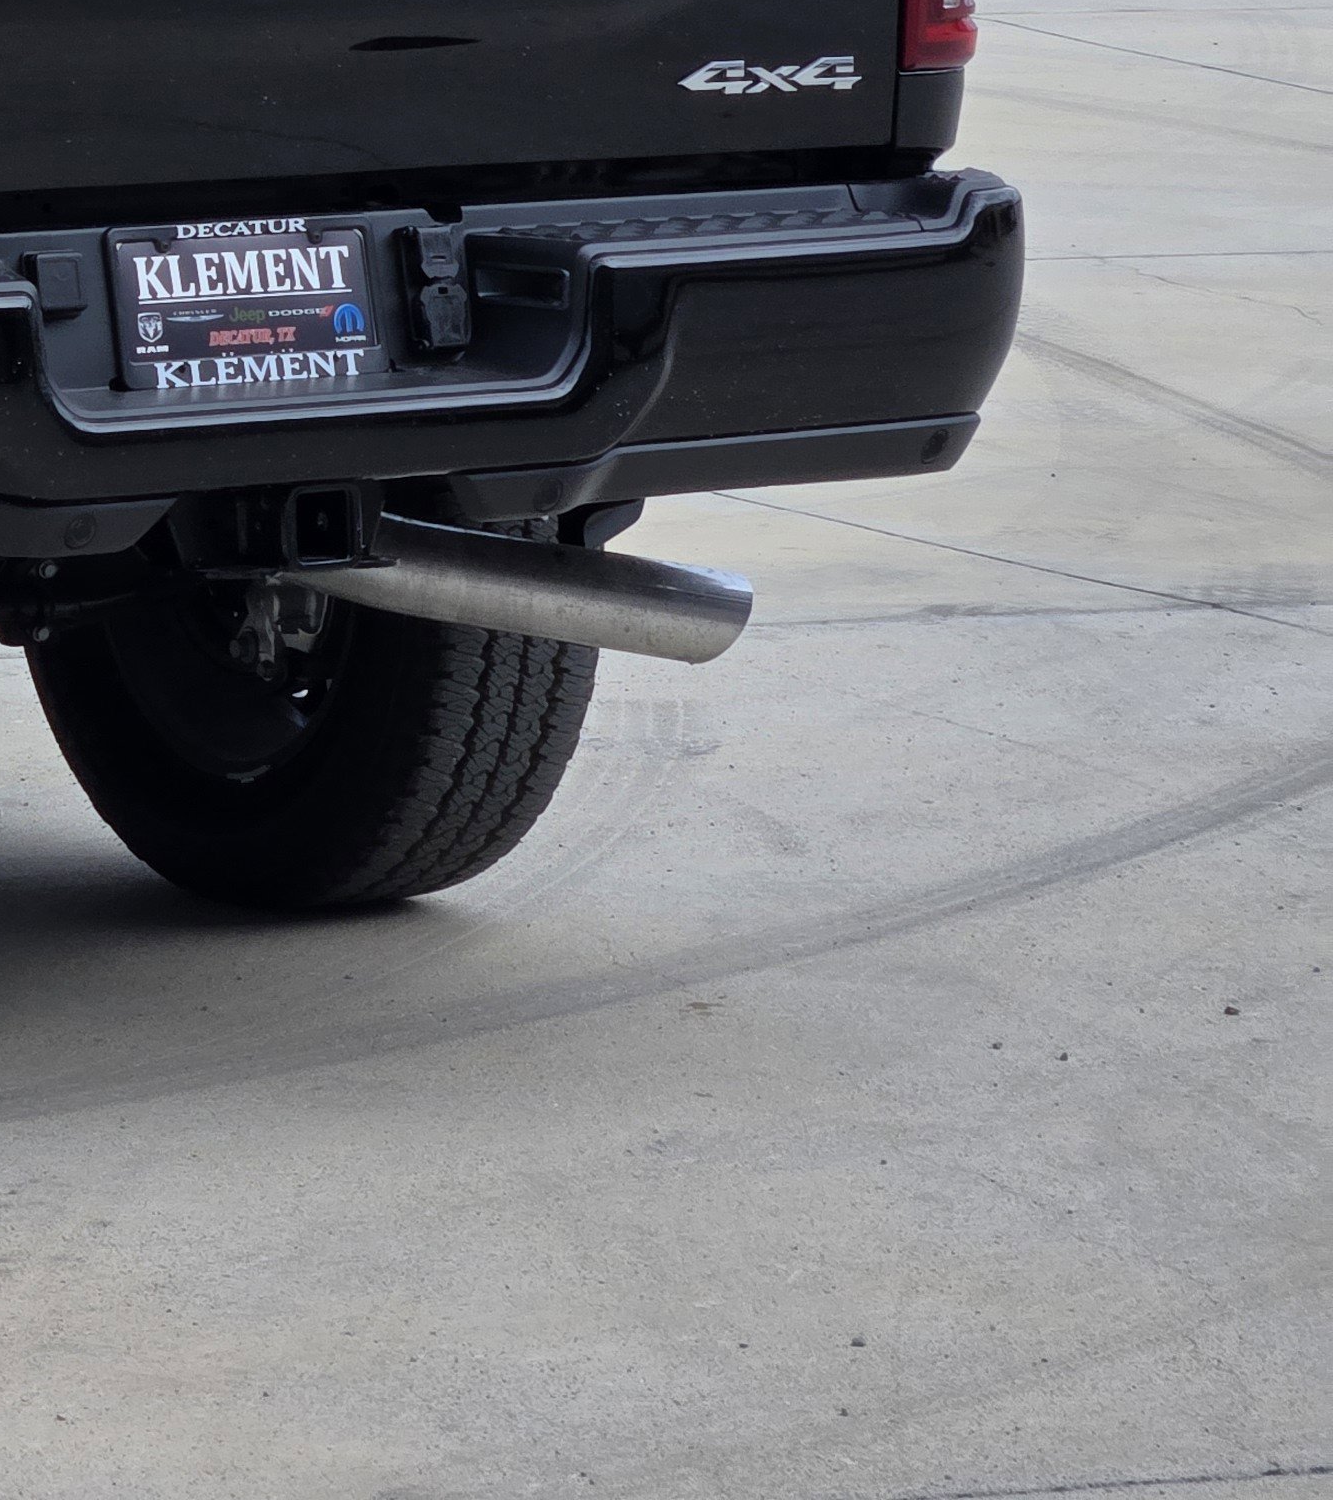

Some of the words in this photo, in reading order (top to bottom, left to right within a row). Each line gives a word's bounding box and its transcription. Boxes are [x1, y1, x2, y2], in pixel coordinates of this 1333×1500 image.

[677, 56, 862, 94] 4x4
[176, 218, 306, 239] DECATUR
[133, 246, 349, 299] KLEMENT
[229, 305, 266, 326] Jeep
[268, 307, 325, 318] DODGE
[277, 326, 296, 343] TX
[136, 345, 170, 355] RAM
[154, 349, 364, 389] KLEMENT
